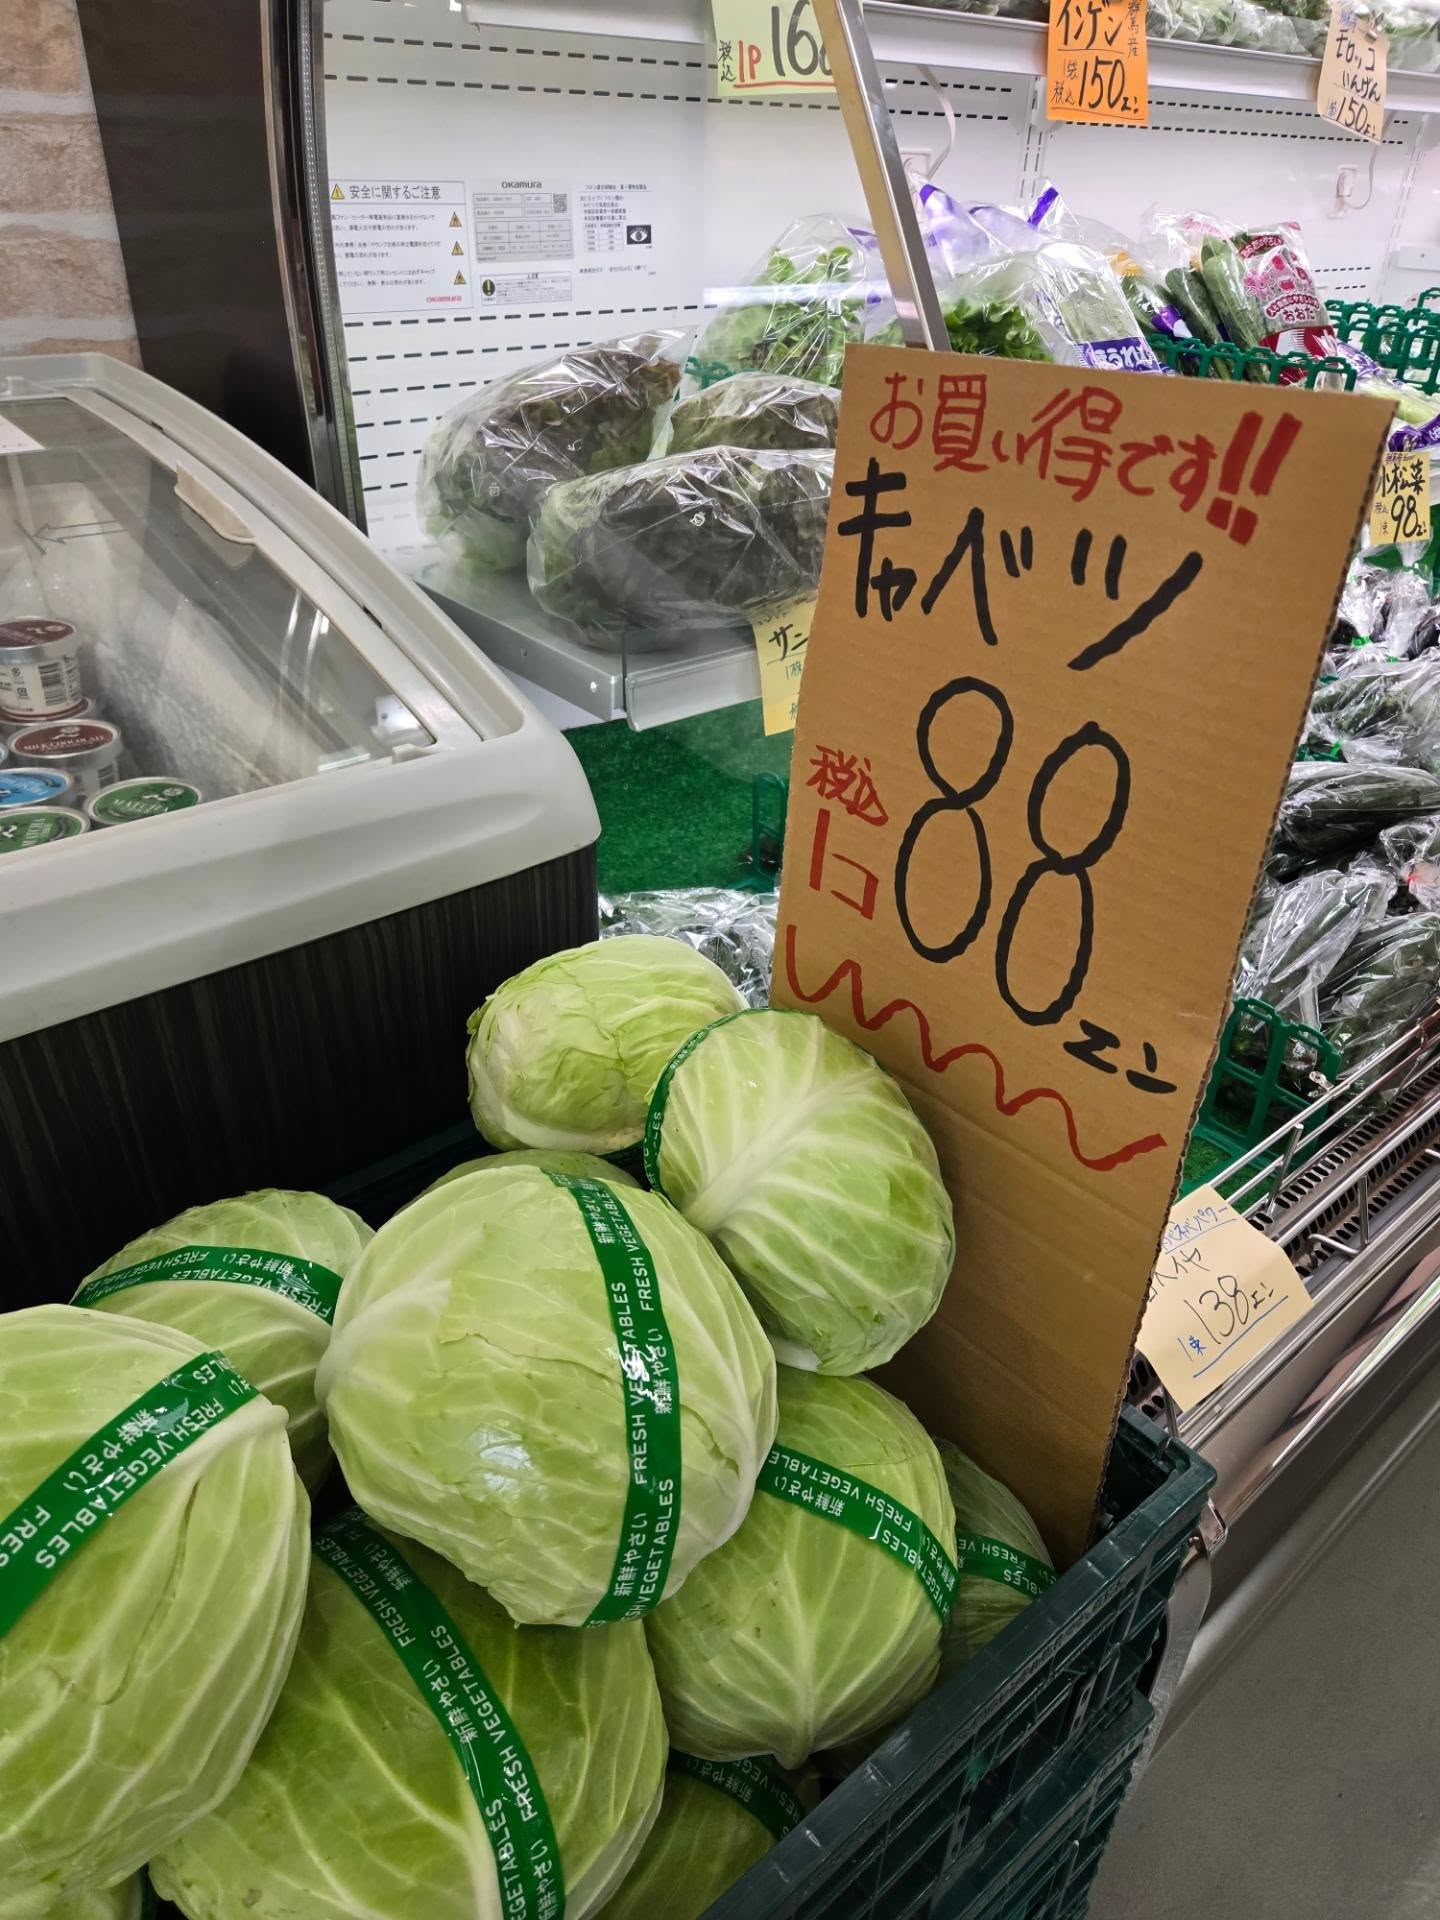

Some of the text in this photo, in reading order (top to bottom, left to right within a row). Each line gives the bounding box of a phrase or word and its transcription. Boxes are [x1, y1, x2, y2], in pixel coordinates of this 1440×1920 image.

[348, 184, 441, 200] 安全に関するご注意
[1376, 459, 1426, 497] 小松菜
[837, 457, 1204, 671] キャベツ
[805, 744, 889, 826] 税込
[163, 1251, 209, 1268] FRESH
[169, 1269, 273, 1292] VEGETABLES
[222, 1254, 295, 1276] 新鮮やさい
[630, 1257, 655, 1312] FRESH
[275, 1285, 332, 1318] FRESH
[62, 1409, 159, 1491] 新鮮やさい
[632, 1413, 649, 1485] FRESH
[35, 1397, 225, 1569] FRESH VEGETABLES
[775, 1475, 846, 1517] 新鮮やさい
[864, 1494, 913, 1533] FRESH
[363, 1543, 414, 1592] 新鮮やさい
[612, 1513, 647, 1597] 新鮮やさい
[638, 1478, 674, 1604] VEGETABLES
[981, 1542, 1028, 1569] FRESH
[315, 1537, 382, 1601] VEGETABLES
[371, 1597, 417, 1648] FRESH
[422, 1658, 479, 1745] 新鮮やさい
[430, 1624, 539, 1823] FRESH VEGETABLES
